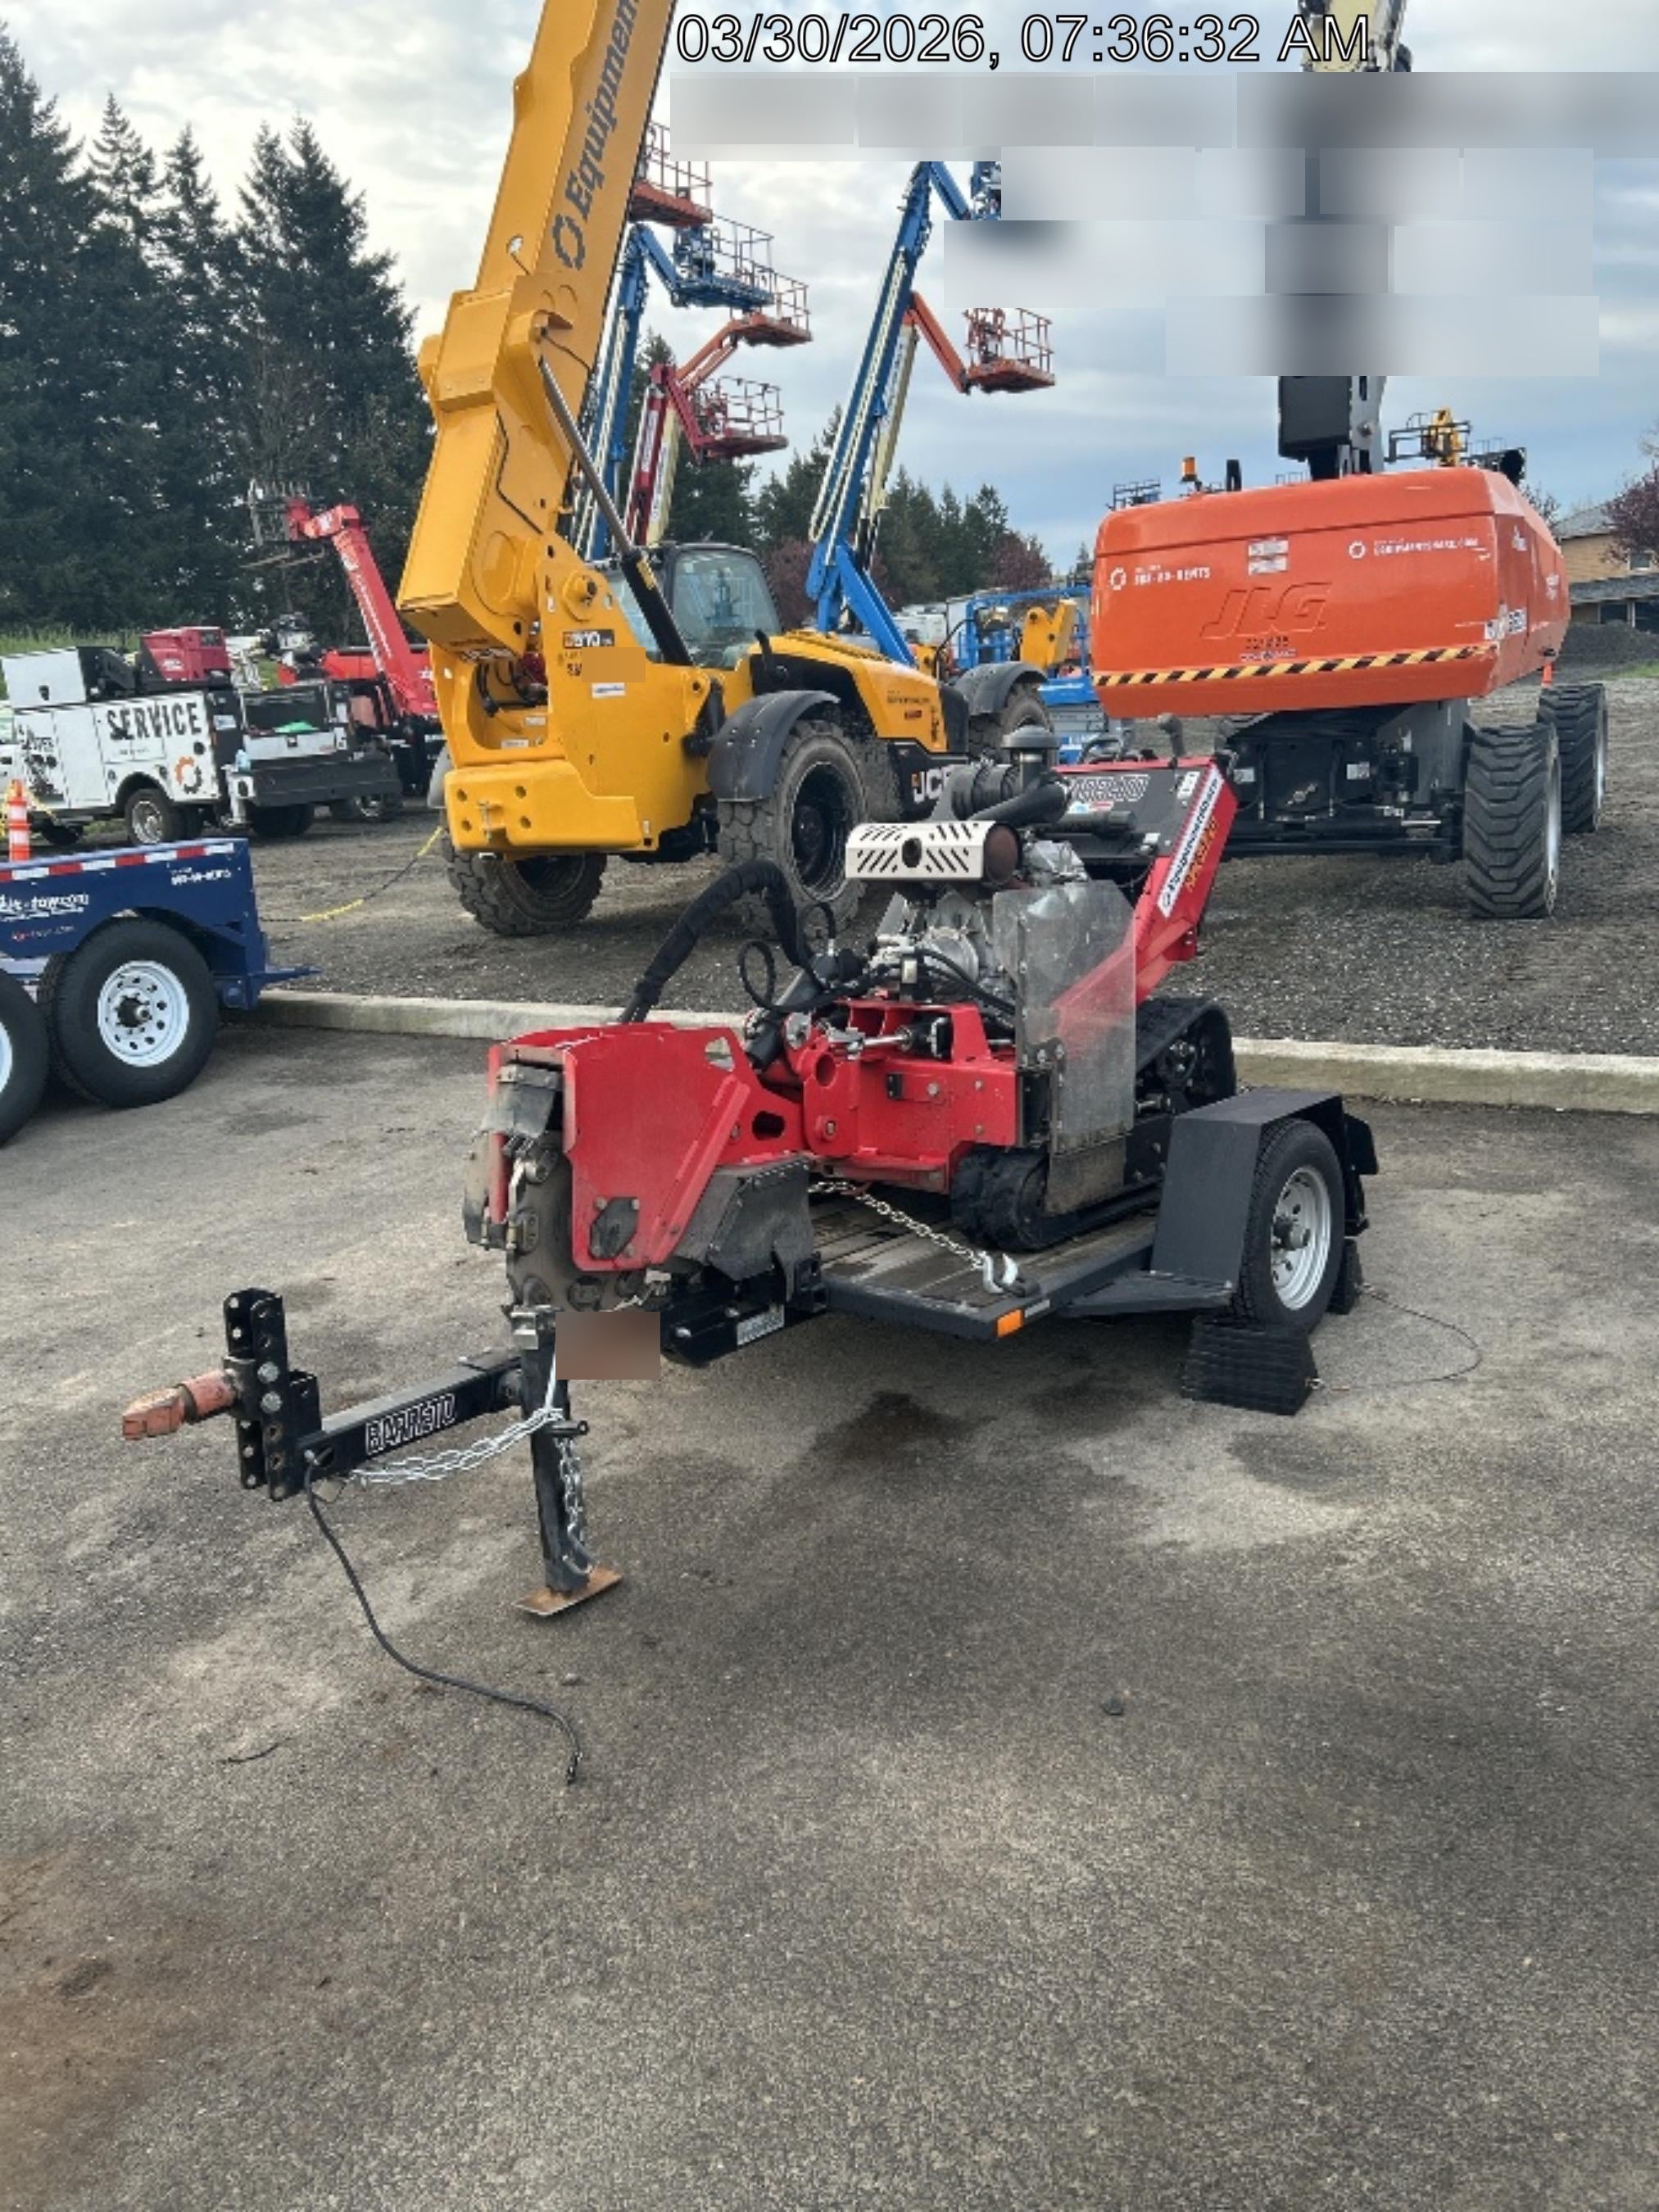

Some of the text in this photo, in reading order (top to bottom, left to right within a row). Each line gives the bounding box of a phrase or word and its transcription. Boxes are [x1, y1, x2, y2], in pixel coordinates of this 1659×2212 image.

[565, 0, 639, 223] Equipmen
[1199, 582, 1332, 641] JLG
[107, 702, 202, 740] SERVICE
[365, 1393, 456, 1455] BARRETO
